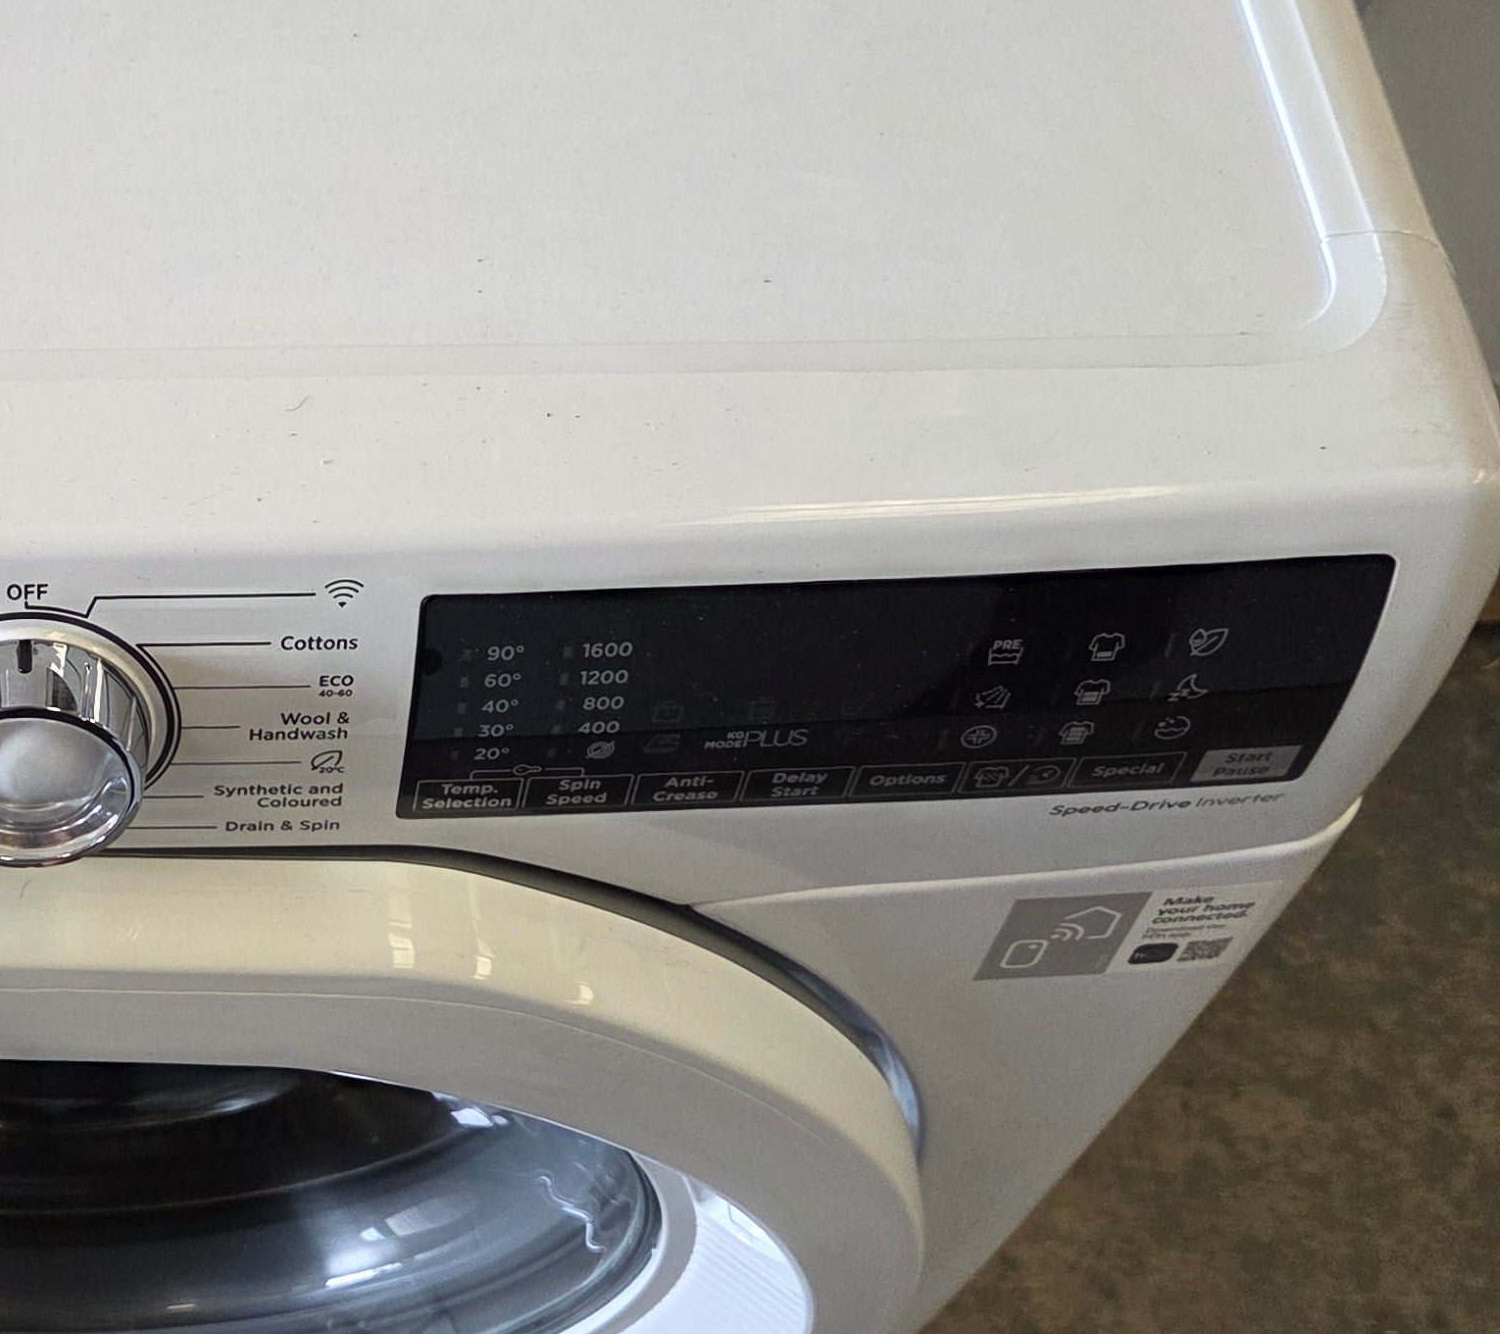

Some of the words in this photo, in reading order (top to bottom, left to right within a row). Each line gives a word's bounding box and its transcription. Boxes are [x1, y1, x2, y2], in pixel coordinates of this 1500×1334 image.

[6, 583, 49, 600] OFF
[280, 635, 359, 650] Cottons
[582, 641, 633, 658] 1600
[993, 638, 1023, 651] PRE
[318, 675, 354, 687] ECO
[580, 669, 629, 685] 1200
[318, 689, 353, 697] 40-60
[582, 695, 625, 711] 800
[280, 712, 331, 725] Wool
[336, 711, 350, 724] &
[250, 727, 348, 741] Handwash
[578, 720, 621, 734] 400
[704, 739, 743, 749] MODE
[1224, 749, 1273, 765] Start
[1091, 761, 1164, 779] Special
[1213, 765, 1269, 779] Pause
[558, 778, 602, 792] Spin
[663, 775, 714, 788] Anti-
[772, 771, 828, 785] Delay
[868, 772, 947, 787] Options
[213, 783, 303, 798] Synthetic
[308, 782, 343, 794] and
[441, 782, 499, 796] Temp.
[652, 790, 718, 802] Crease
[770, 785, 820, 798] Start
[257, 796, 343, 808] Coloured
[422, 797, 512, 810] Selection
[546, 792, 607, 806] Speed
[1049, 798, 1192, 818] Speed-Drive
[1195, 792, 1286, 807] Inverter
[225, 820, 275, 832] Drain
[280, 820, 293, 831] &
[299, 819, 340, 832] Spin
[1163, 895, 1215, 906] Make
[1157, 905, 1201, 916] your
[1202, 902, 1256, 912] home
